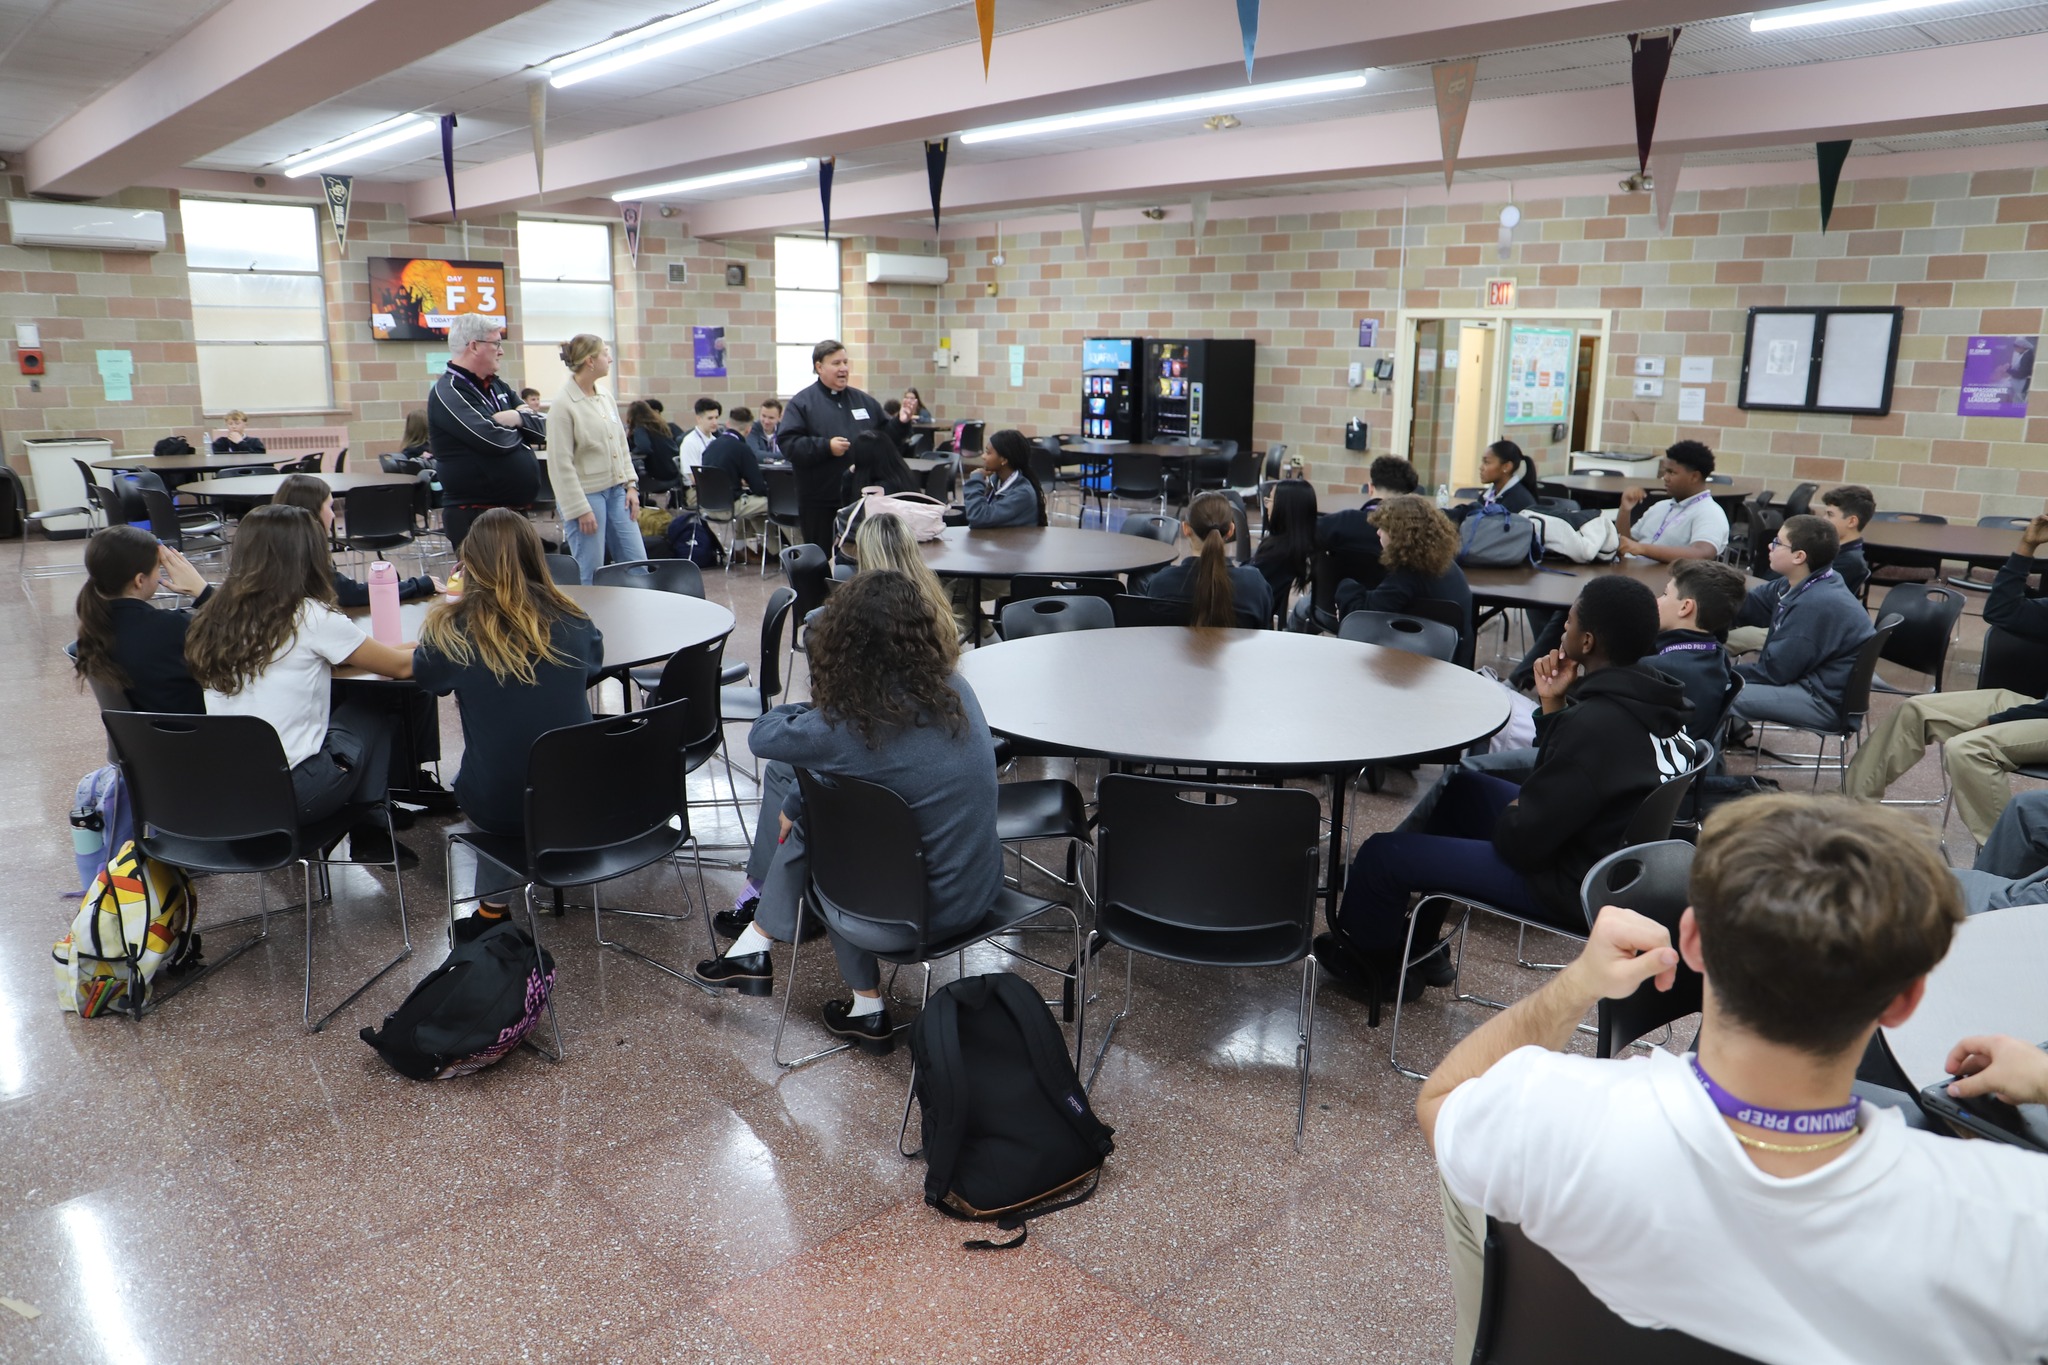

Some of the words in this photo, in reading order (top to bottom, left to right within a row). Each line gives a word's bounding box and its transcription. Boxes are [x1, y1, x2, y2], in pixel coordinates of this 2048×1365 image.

[446, 275, 463, 283] DAY
[477, 276, 495, 284] BELL
[446, 285, 466, 311] F
[477, 286, 497, 312] 3
[1491, 282, 1511, 305] EXIT
[1963, 386, 2008, 394] COMPASSIONATE
[1665, 643, 1693, 653] EDMUND
[1737, 1109, 1790, 1131] PREP
